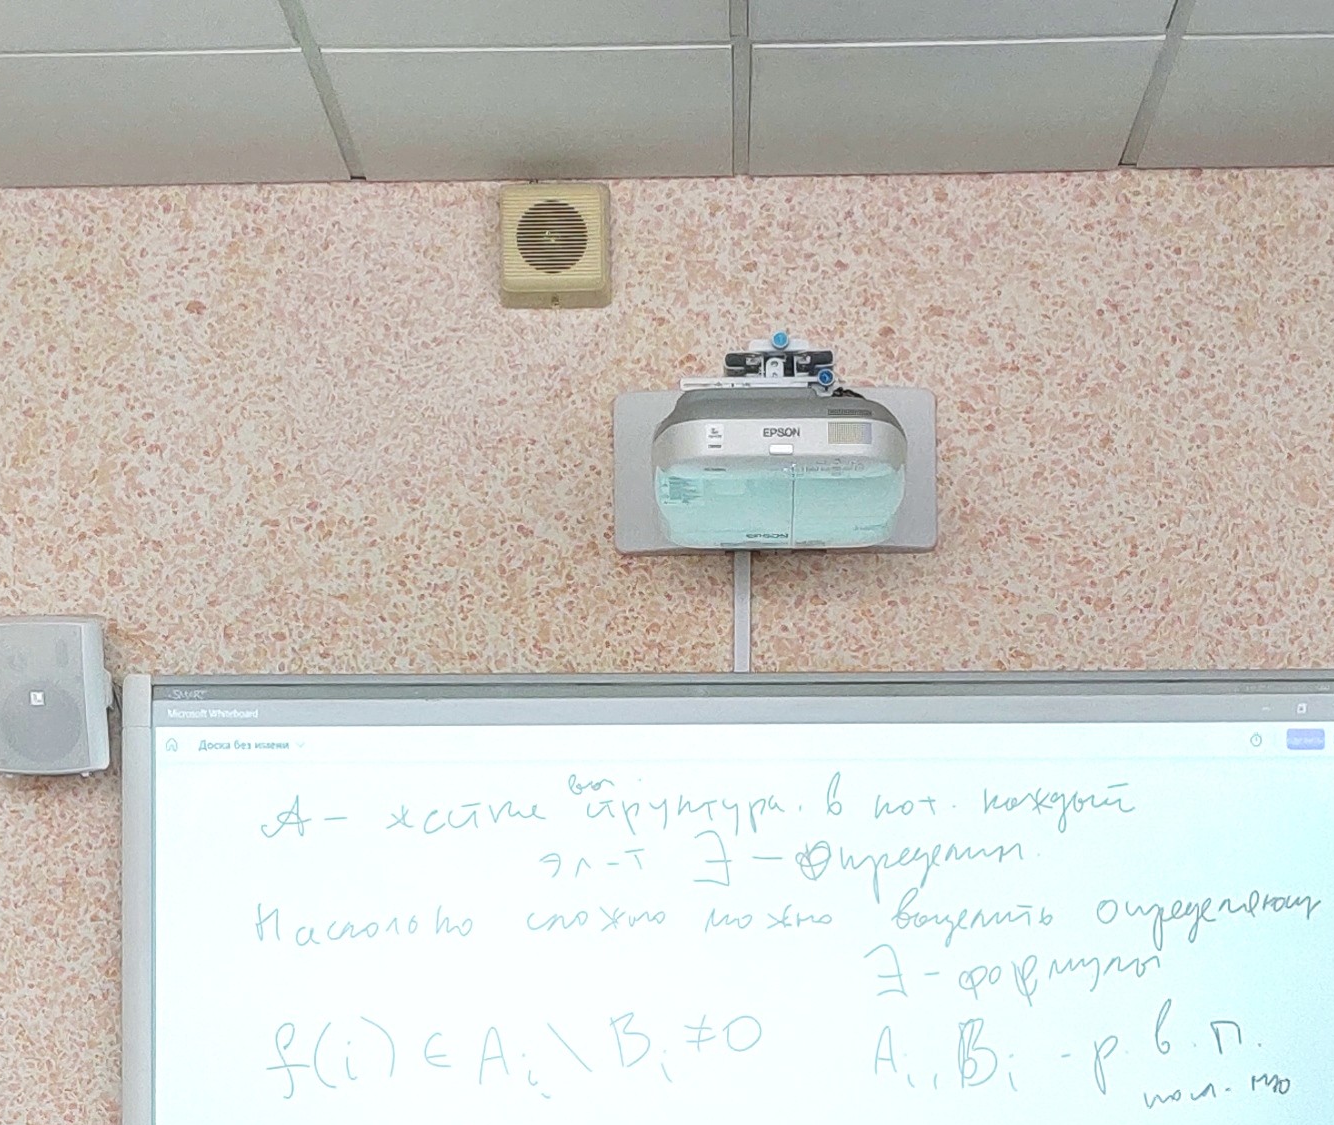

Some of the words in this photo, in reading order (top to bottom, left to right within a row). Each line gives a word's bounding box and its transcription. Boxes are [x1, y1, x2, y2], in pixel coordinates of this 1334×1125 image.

[762, 427, 801, 438] EPSON
[167, 709, 208, 719] Microsoft
[209, 708, 259, 719] Whiteboard
[198, 739, 231, 752] Доска
[234, 739, 252, 750] без
[254, 740, 290, 750] имени
[826, 771, 843, 815] в
[983, 783, 1136, 833] каждый
[704, 904, 833, 933] можно
